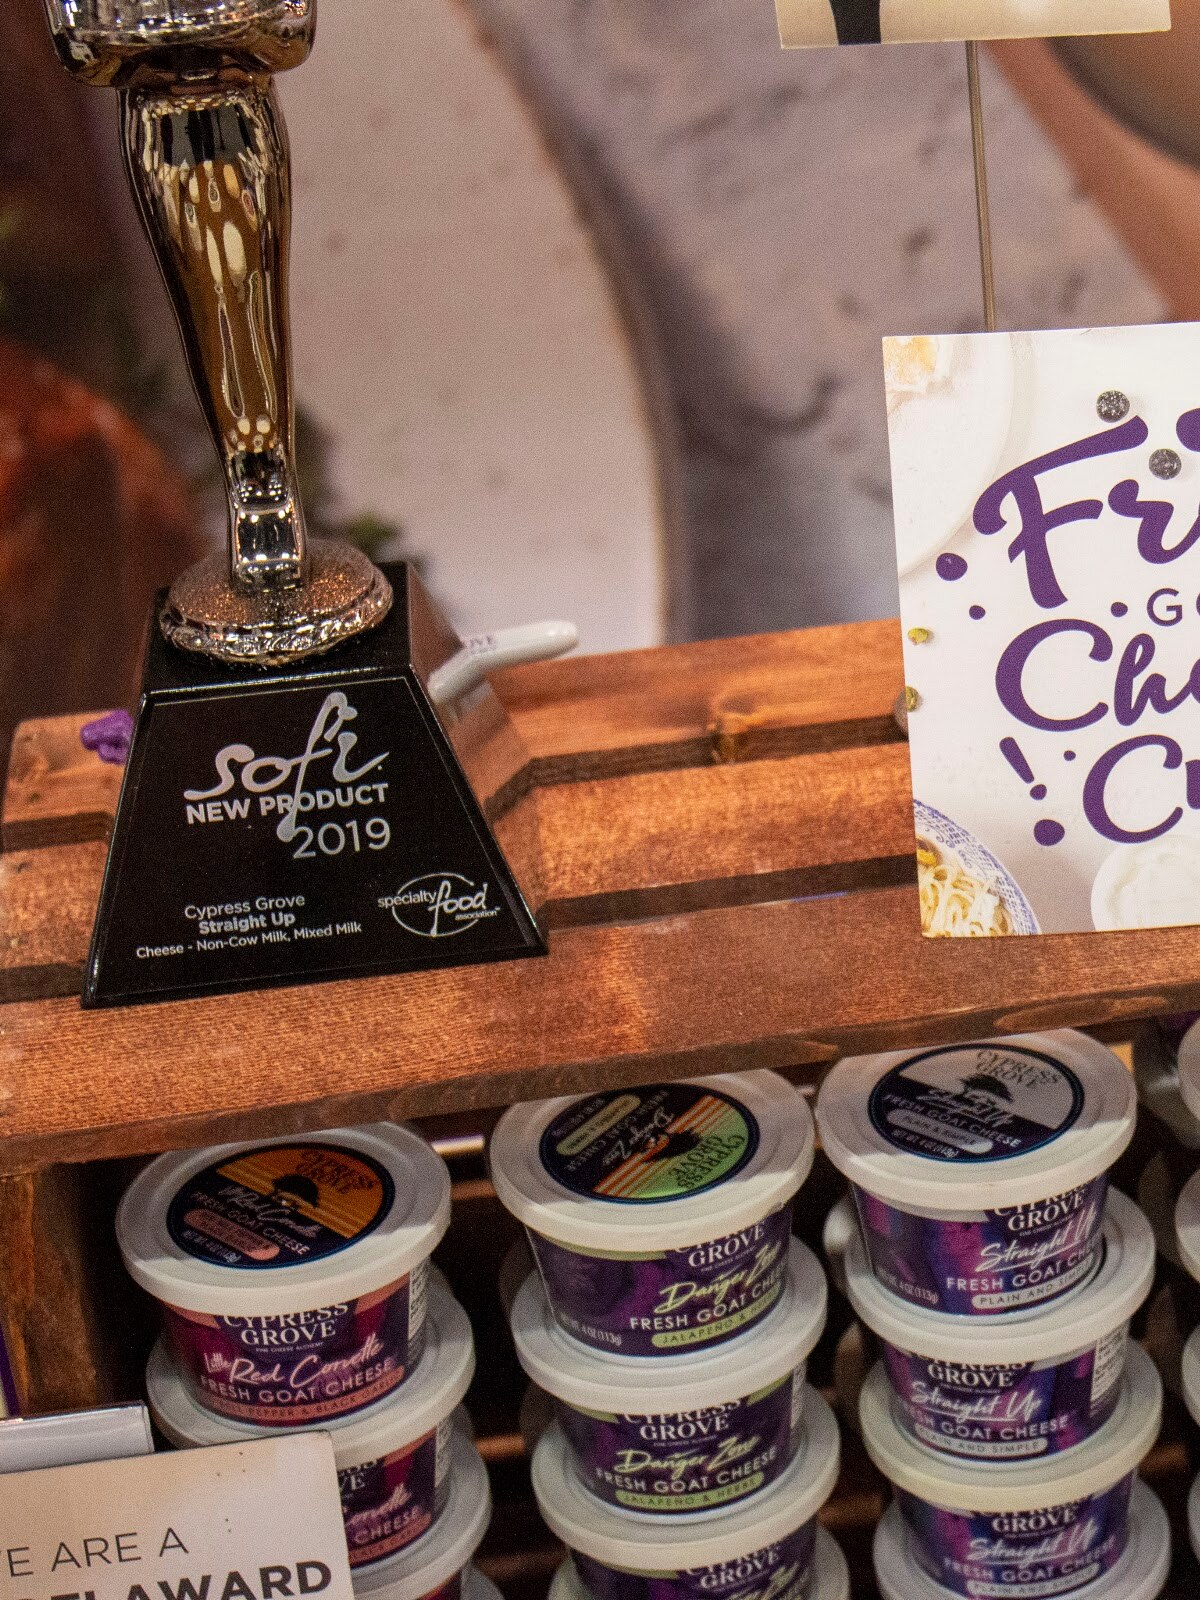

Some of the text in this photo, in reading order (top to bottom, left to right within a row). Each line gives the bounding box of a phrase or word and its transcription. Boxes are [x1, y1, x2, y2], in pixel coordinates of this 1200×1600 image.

[183, 691, 390, 842] sofi
[186, 783, 389, 824] NEW PRODUCT
[293, 817, 391, 859] 2019
[184, 895, 305, 920] Cypress Grove
[377, 890, 437, 909] specialty
[427, 880, 488, 937] food
[136, 944, 184, 959] Cheese
[196, 936, 258, 951] Non-Cow
[262, 931, 291, 943] Milk,
[294, 924, 333, 940] Mixed
[336, 921, 362, 934] Milk
[199, 911, 296, 935] Straight Up
[975, 1061, 1040, 1090] GROVE
[976, 1050, 1063, 1085] CYPRESS
[928, 1109, 966, 1129] GOAT
[967, 1123, 1022, 1148] CHEESE
[668, 1136, 723, 1176] GROVE
[677, 1134, 745, 1188] CYPRESS
[1008, 1189, 1085, 1232] GROVE
[228, 1209, 264, 1230] GOAT
[262, 1225, 311, 1256] CHEESE
[688, 1225, 766, 1268] GROVE
[975, 1219, 1072, 1274] Straight
[654, 1267, 750, 1315] Danger
[946, 1259, 1066, 1292] FRESH GOAT
[630, 1314, 688, 1330] FRESH
[696, 1293, 748, 1323] GOAT
[980, 1283, 1053, 1306] PLAIN AND
[240, 1319, 337, 1347] GROVE
[200, 1356, 393, 1404] FRESH GOAT CHEESE
[229, 1357, 286, 1385] Red
[927, 1363, 1015, 1389] GROVE
[248, 1407, 294, 1418] PEPPER
[315, 1395, 357, 1414] BLACK
[911, 1380, 1044, 1424] Straight Up
[639, 1412, 730, 1441] GROVE
[941, 1414, 1070, 1440] GOAT CHEESE
[613, 1447, 708, 1480] Danger
[957, 1440, 1040, 1454] AND SIMPLE
[595, 1446, 777, 1494] FRESH GOAT CHEESE
[991, 1507, 1077, 1533] GROVE
[0, 1527, 190, 1577] E ARE A
[699, 1550, 782, 1591] GROVE
[943, 1557, 994, 1582] FRESH
[1001, 1566, 1054, 1583] GOAT
